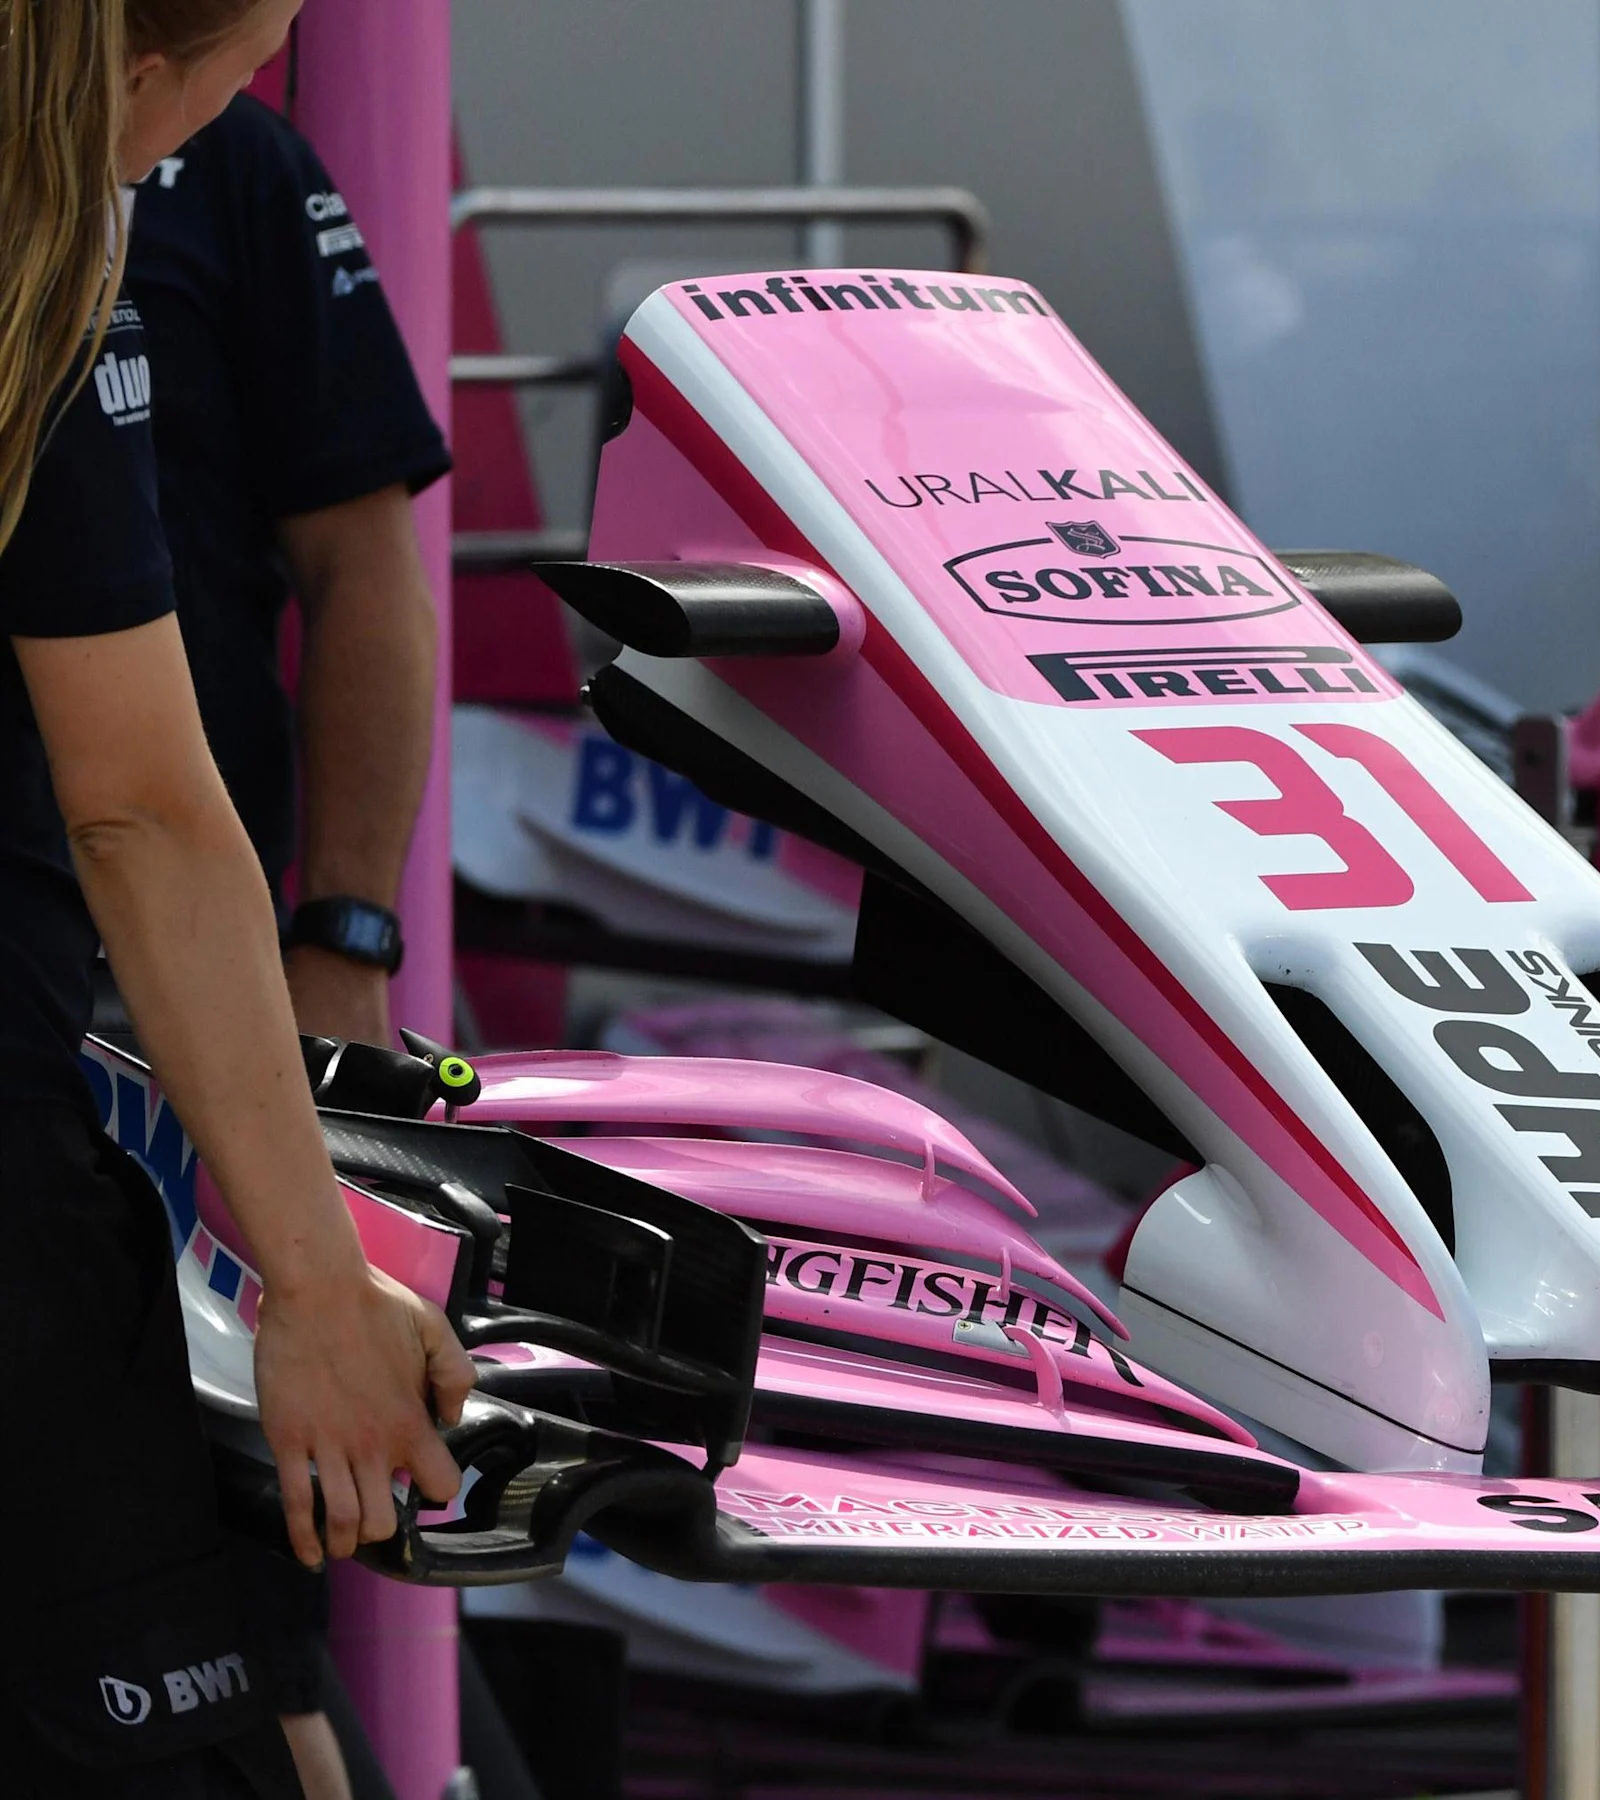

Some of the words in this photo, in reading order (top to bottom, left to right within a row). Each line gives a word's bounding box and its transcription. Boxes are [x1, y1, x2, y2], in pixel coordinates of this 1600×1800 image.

[682, 274, 1049, 321] infinitum
[864, 469, 1209, 508] URALKALI
[984, 563, 1275, 603] SOFINA
[1025, 646, 1381, 702] PIRELLI
[1127, 723, 1537, 911] 31
[163, 1652, 249, 1713] BWT
